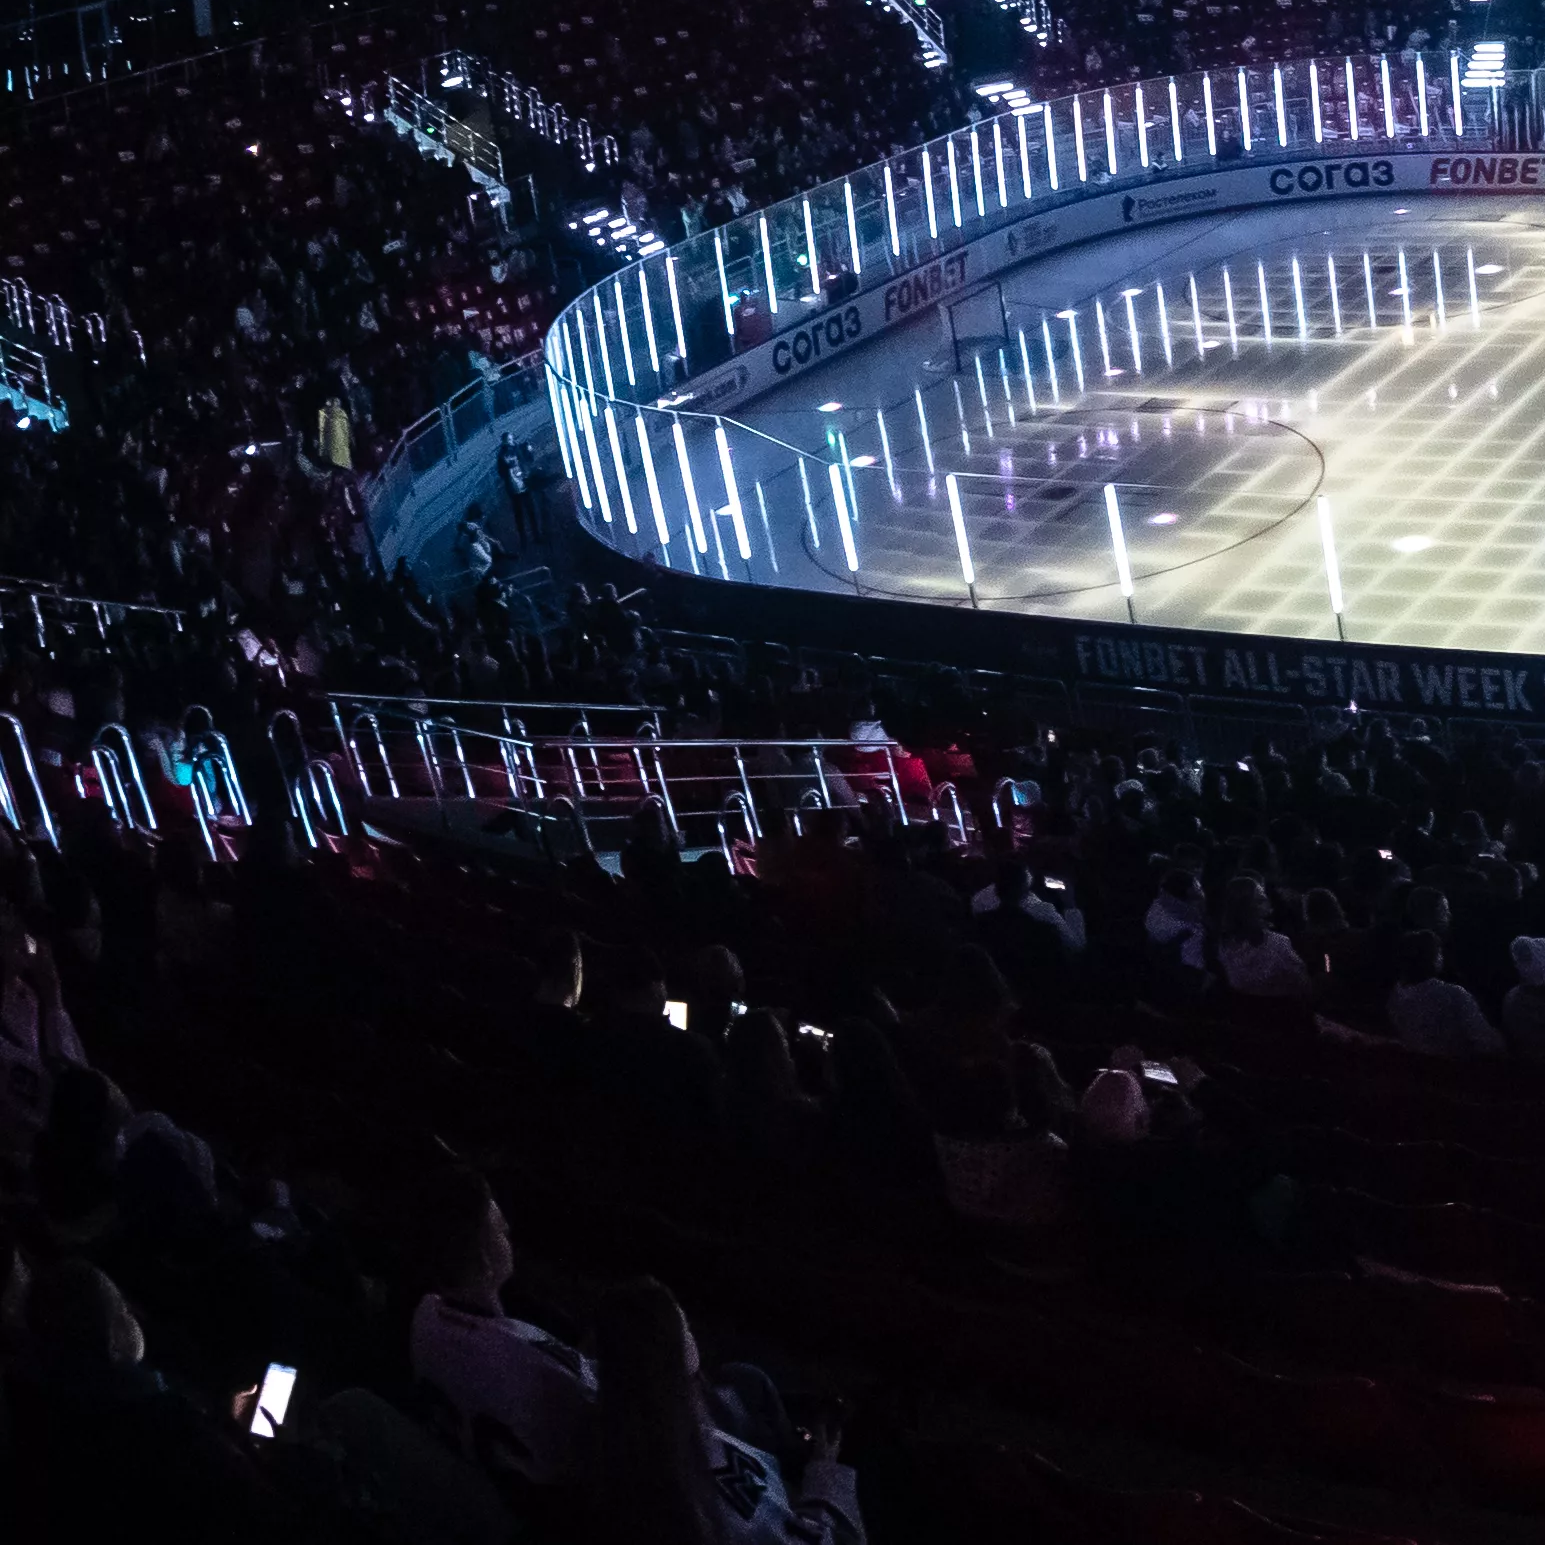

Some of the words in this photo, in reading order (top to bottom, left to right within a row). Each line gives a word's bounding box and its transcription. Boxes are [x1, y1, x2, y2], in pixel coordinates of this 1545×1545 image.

[884, 256, 972, 322] FONBET
[1074, 633, 1211, 687] FONBET
[1222, 648, 1402, 704] ALL-STAR
[1411, 660, 1533, 712] WEEK
